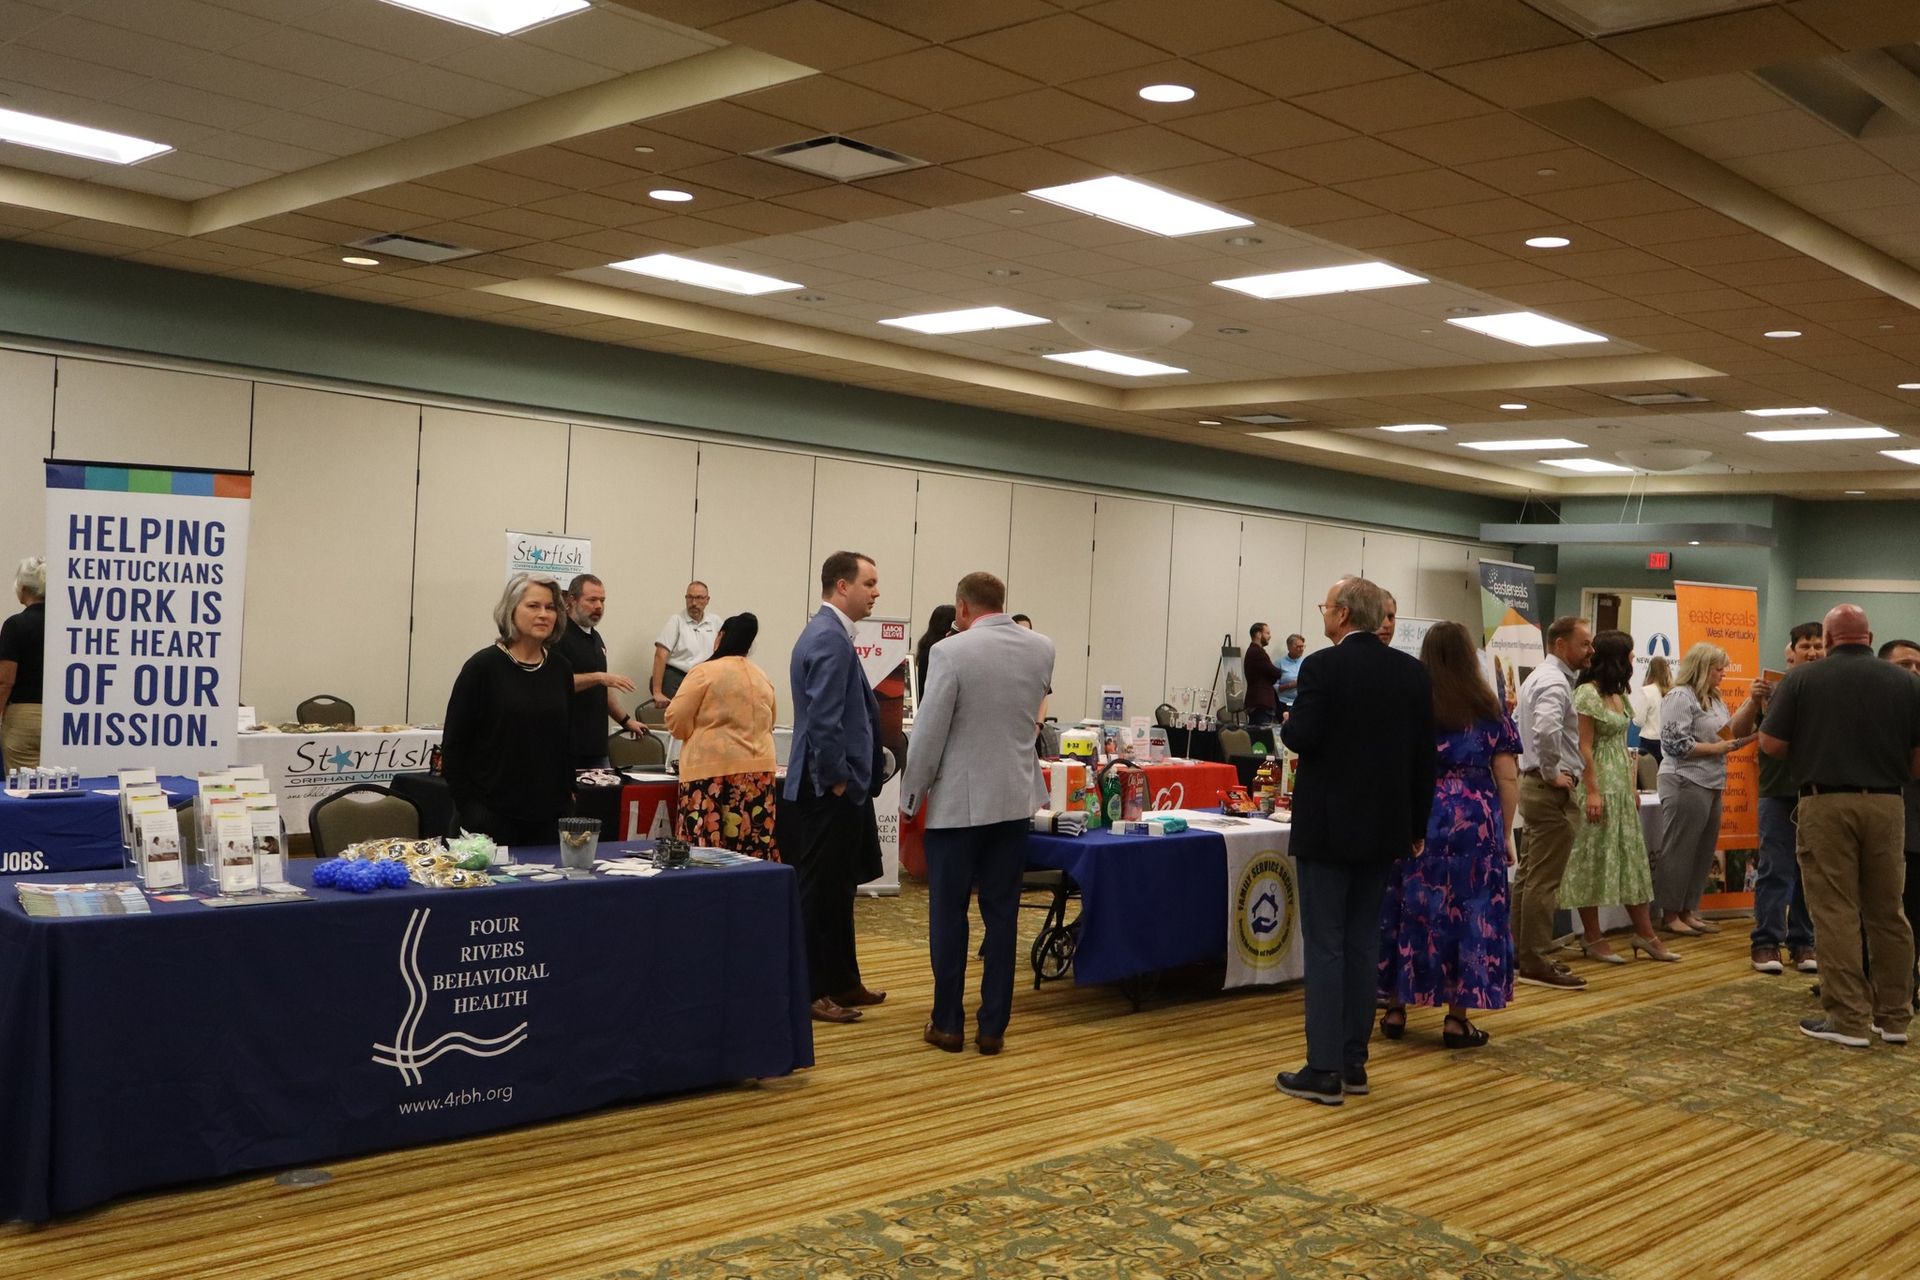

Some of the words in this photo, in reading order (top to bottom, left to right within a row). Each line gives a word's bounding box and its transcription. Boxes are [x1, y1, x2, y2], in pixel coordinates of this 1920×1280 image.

[69, 514, 225, 558] HELPING
[68, 557, 224, 585] KENTUCKIANS
[1649, 552, 1668, 568] EXIT
[1493, 580, 1528, 598] easterseals
[68, 585, 176, 623] WORK
[190, 590, 222, 625] IS
[1688, 608, 1757, 628] easterseals
[66, 627, 120, 656] THE
[130, 629, 222, 658] HEART
[1705, 627, 1723, 639] West
[1724, 629, 1757, 643] Kentucky
[854, 644, 882, 659] ny's
[1636, 656, 1650, 664] NEW
[65, 662, 117, 706] OF
[133, 664, 220, 707] OUR
[62, 712, 218, 747] MISSION.
[290, 774, 355, 785] ORPHAN
[878, 825, 889, 833] KE
[0, 851, 49, 872] JOBS.
[1238, 874, 1251, 911] FAMILY
[1251, 860, 1279, 878] SERVICE
[1279, 866, 1294, 905] SOCIETY
[469, 917, 520, 936] FOUR
[460, 941, 525, 963] RIVERS
[432, 963, 550, 992] BEHAVIORAL
[453, 990, 528, 1014] HEALTH
[399, 1086, 513, 1114] www.4rbh.org
